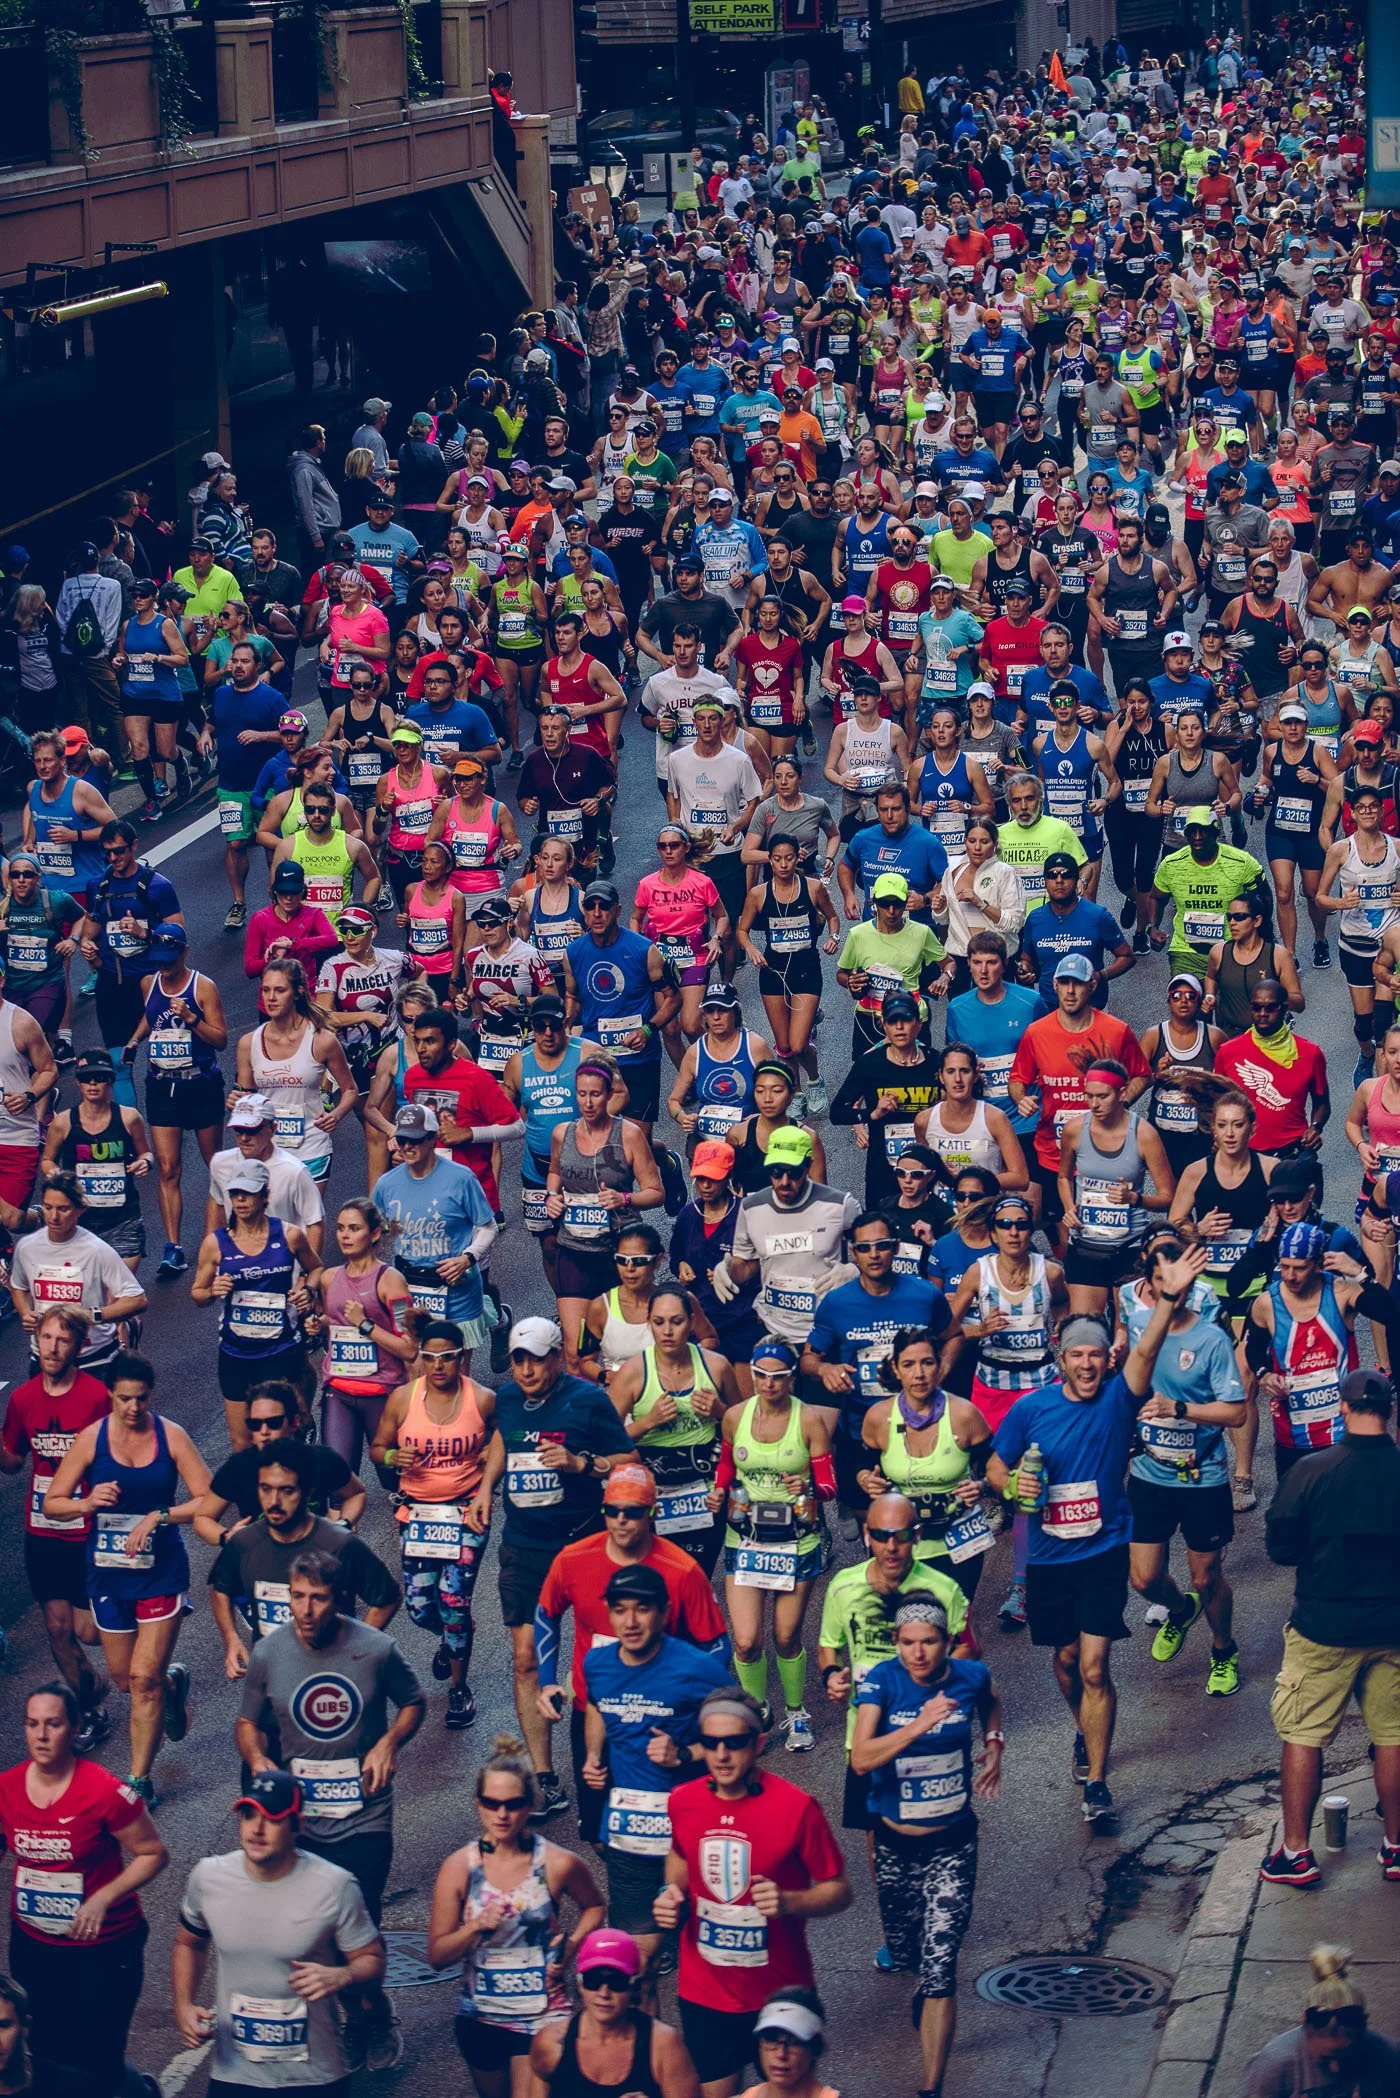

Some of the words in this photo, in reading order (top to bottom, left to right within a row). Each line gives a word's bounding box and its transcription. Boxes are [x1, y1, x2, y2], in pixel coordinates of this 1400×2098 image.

[694, 4, 727, 15] SELF
[733, 4, 770, 14] PARK
[694, 18, 773, 29] ATTENDANT
[607, 527, 644, 538] PURDUE
[362, 541, 391, 550] Team
[1052, 542, 1085, 553] CrossFit
[360, 549, 393, 558] RMHC
[1125, 620, 1146, 630] 35276
[934, 671, 956, 681] 34628
[665, 698, 696, 712] AUBU
[759, 706, 781, 717] 31477
[853, 740, 882, 749] EVERY
[1127, 739, 1164, 752] WILL
[848, 750, 886, 759] MOTHER
[850, 758, 886, 767] COUNTS
[358, 764, 381, 775] 35348
[409, 812, 433, 826] 35685
[691, 812, 697, 822] G
[701, 811, 727, 823] 38623
[1276, 810, 1283, 820] G
[1285, 810, 1310, 823] 32154
[558, 821, 583, 833] 42460
[941, 832, 966, 844] 39927
[461, 843, 486, 856] 36260
[316, 888, 343, 901] 16743
[652, 888, 697, 904] CINDY
[1188, 885, 1218, 895] LOVE
[1185, 899, 1223, 909] SHACK
[413, 930, 419, 941] G
[421, 929, 448, 941] 38915
[772, 931, 778, 941] F
[782, 929, 810, 941] 24955
[1185, 924, 1192, 934] G
[1195, 925, 1223, 937] 39975
[538, 937, 544, 947] G
[1036, 939, 1060, 949] Chicago
[1061, 938, 1092, 947] Marathon
[8, 948, 14, 959] F
[18, 948, 46, 961] 24878
[1054, 945, 1070, 953] 2017
[474, 963, 519, 978] MARCE
[346, 971, 393, 993] MARCELA
[600, 1034, 608, 1046] G
[150, 1044, 156, 1056] G
[161, 1042, 191, 1056] 31361
[480, 1045, 487, 1056] G
[524, 1075, 557, 1087] DAVID
[530, 1087, 572, 1100] CHICAGO
[556, 1106, 574, 1114] SPORTS
[1156, 1104, 1163, 1117] G
[1166, 1103, 1196, 1119] 35351
[76, 1140, 125, 1162] RUN
[938, 1139, 971, 1151] KATIE
[91, 1178, 125, 1193] 33239
[564, 1209, 572, 1222] G
[575, 1208, 609, 1224] 31892
[1082, 1209, 1090, 1222] G
[1095, 1208, 1128, 1226] 36676
[773, 1236, 810, 1252] ANDY
[239, 1263, 293, 1280] PORTLAND
[46, 1284, 82, 1301] 15339
[765, 1288, 773, 1303] G
[778, 1290, 813, 1310] 35368
[412, 1294, 446, 1313] 31893
[232, 1307, 241, 1321] G
[846, 1329, 880, 1342] Chicago
[1007, 1330, 1042, 1349] 33361
[331, 1344, 338, 1360] G
[341, 1344, 374, 1361] 38101
[861, 1365, 870, 1380] G
[1288, 1394, 1298, 1409] G
[1303, 1387, 1340, 1409] 30965
[1141, 1426, 1150, 1441] G
[1156, 1429, 1195, 1447] 32989
[508, 1474, 517, 1491] G
[522, 1473, 561, 1491] 33172
[1058, 1501, 1098, 1522] 16339
[409, 1525, 419, 1541] G
[423, 1523, 460, 1542] 32085
[97, 1533, 107, 1549] G
[112, 1532, 153, 1552] 388
[945, 1531, 956, 1549] G
[738, 1554, 748, 1569] G
[754, 1553, 796, 1573] 31936
[257, 1603, 267, 1620] G
[312, 1780, 361, 1801] 35926
[901, 1781, 912, 1800] G
[608, 1812, 619, 1831] G
[14, 1833, 72, 1851] Chicago
[17, 1894, 28, 1912] G
[700, 1920, 711, 1942] G
[715, 1927, 764, 1949] 35741
[234, 2022, 246, 2040] G
[252, 2023, 305, 2044] 36917
